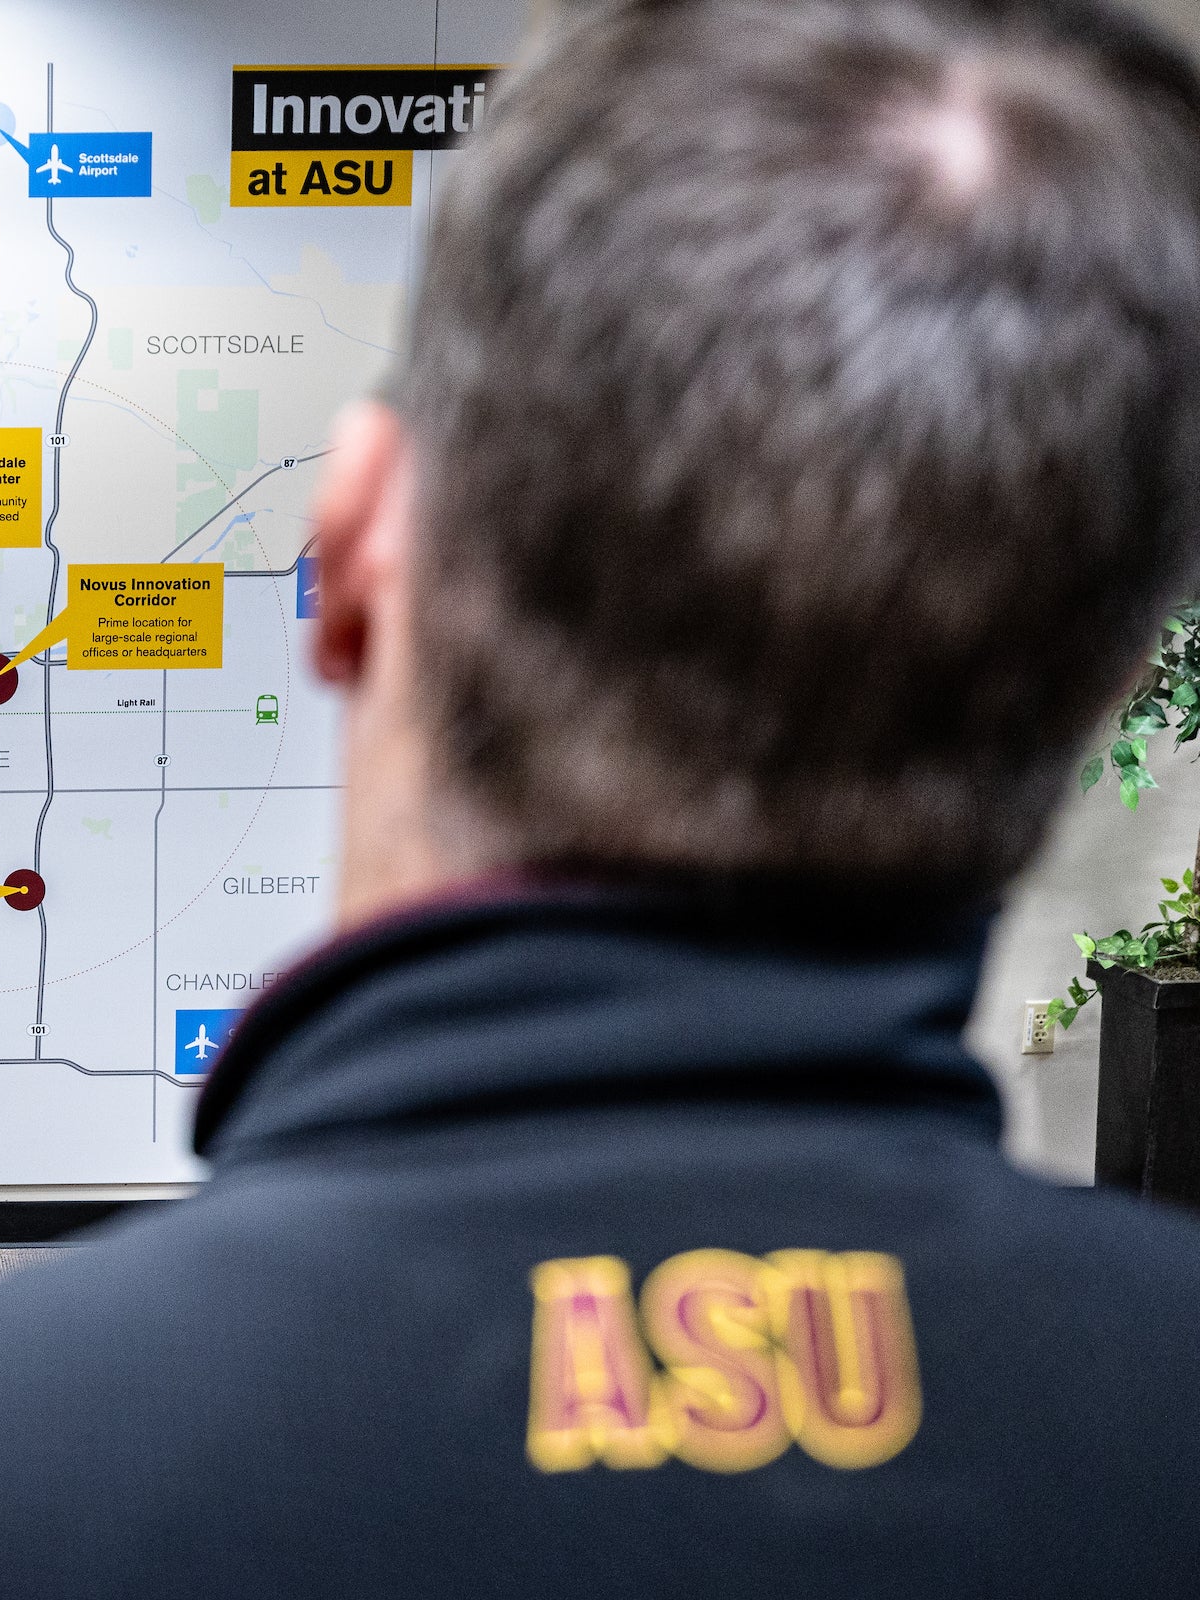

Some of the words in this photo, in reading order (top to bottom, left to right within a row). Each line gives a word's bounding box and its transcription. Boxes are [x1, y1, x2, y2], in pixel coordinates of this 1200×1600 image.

[252, 82, 486, 135] Innovati
[78, 152, 140, 164] Scottsdale
[78, 165, 119, 178] Airport
[247, 162, 288, 196] at
[299, 160, 394, 196] ASU
[146, 334, 305, 355] SCOTTSDALE
[49, 436, 66, 446] 101
[283, 459, 295, 468] 87
[79, 577, 127, 592] Novus
[131, 577, 212, 591] Innovation
[113, 593, 178, 607] Corridor
[97, 616, 129, 628] Prime
[132, 616, 175, 628] location
[177, 616, 193, 628] for
[91, 631, 153, 646] large-scale
[154, 631, 199, 645] regional
[81, 646, 119, 658] offices
[121, 648, 134, 658] or
[135, 646, 208, 660] headquarters
[117, 699, 139, 709] Light
[140, 698, 156, 706] Rail
[157, 755, 169, 766] 87
[222, 876, 321, 896] GILBERT
[30, 1025, 47, 1035] 101
[525, 1246, 926, 1476] ASU
